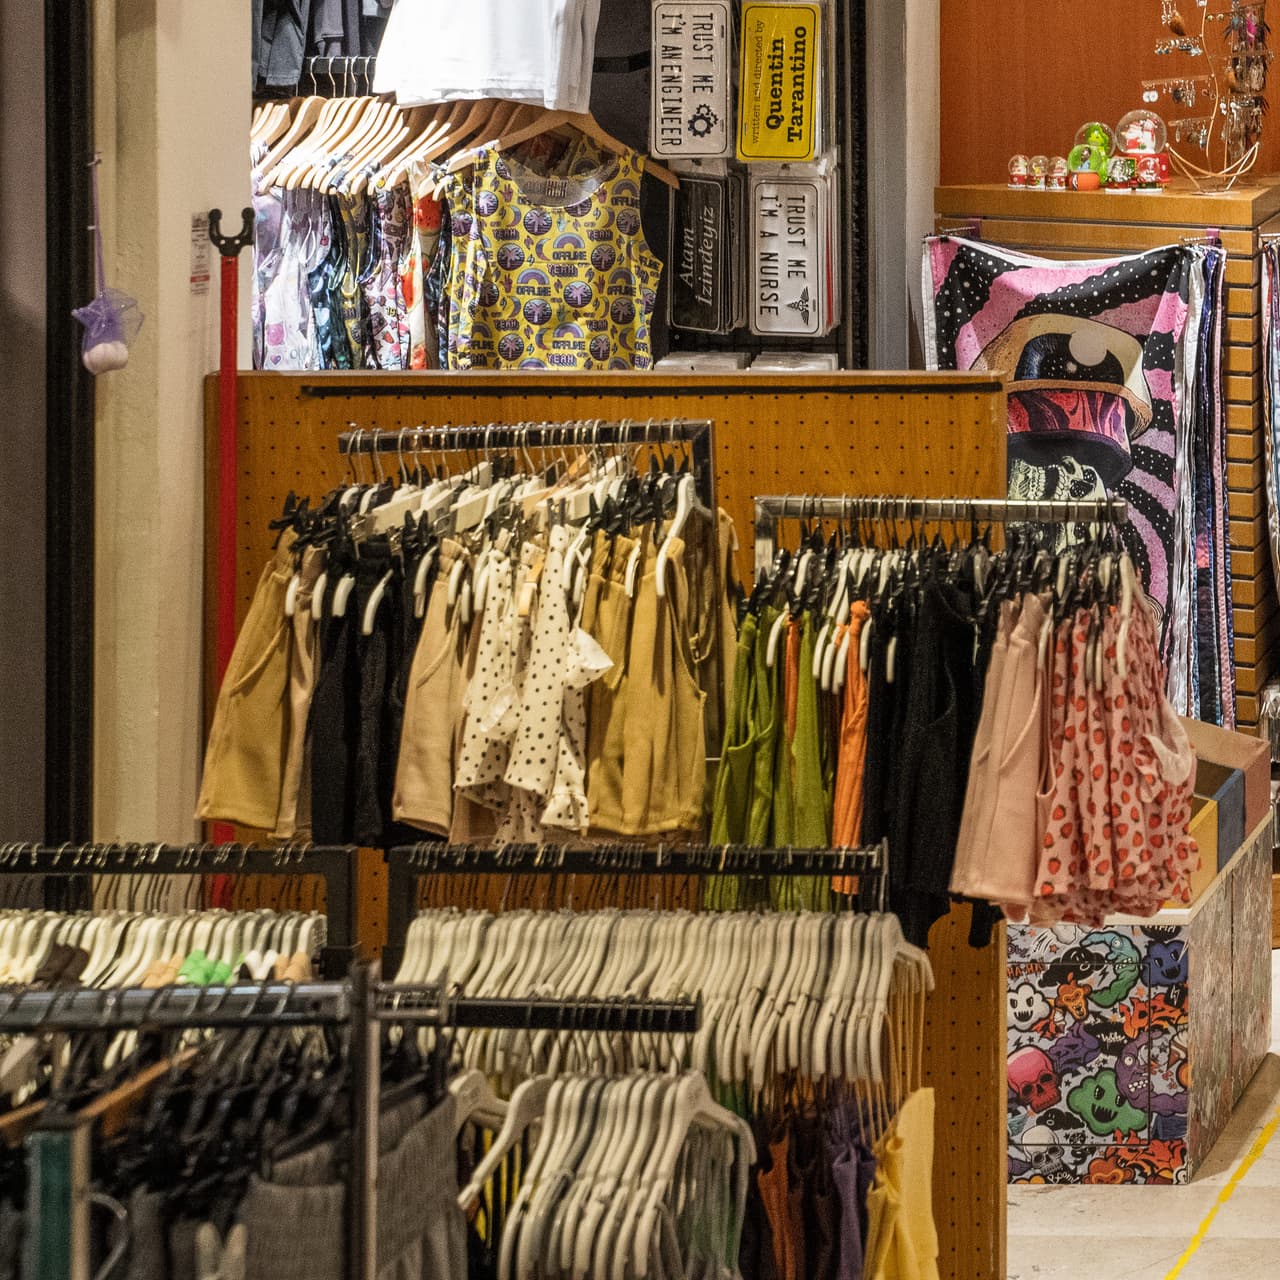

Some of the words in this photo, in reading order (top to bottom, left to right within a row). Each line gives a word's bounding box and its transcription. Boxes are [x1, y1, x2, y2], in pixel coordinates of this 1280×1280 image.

[661, 13, 687, 36] I'M
[692, 13, 713, 62] TRUST
[757, 20, 765, 33] by
[755, 35, 763, 79] directed
[661, 64, 683, 146] ENGINEER
[692, 75, 714, 94] ME
[766, 37, 784, 130] Quentin
[788, 26, 807, 143] Tarantino
[760, 195, 783, 217] I'M
[787, 195, 806, 247] TRUST
[680, 227, 694, 289] Atam
[695, 207, 718, 306] İzindeyiz
[788, 259, 806, 279] ME
[760, 252, 779, 316] NURSE
